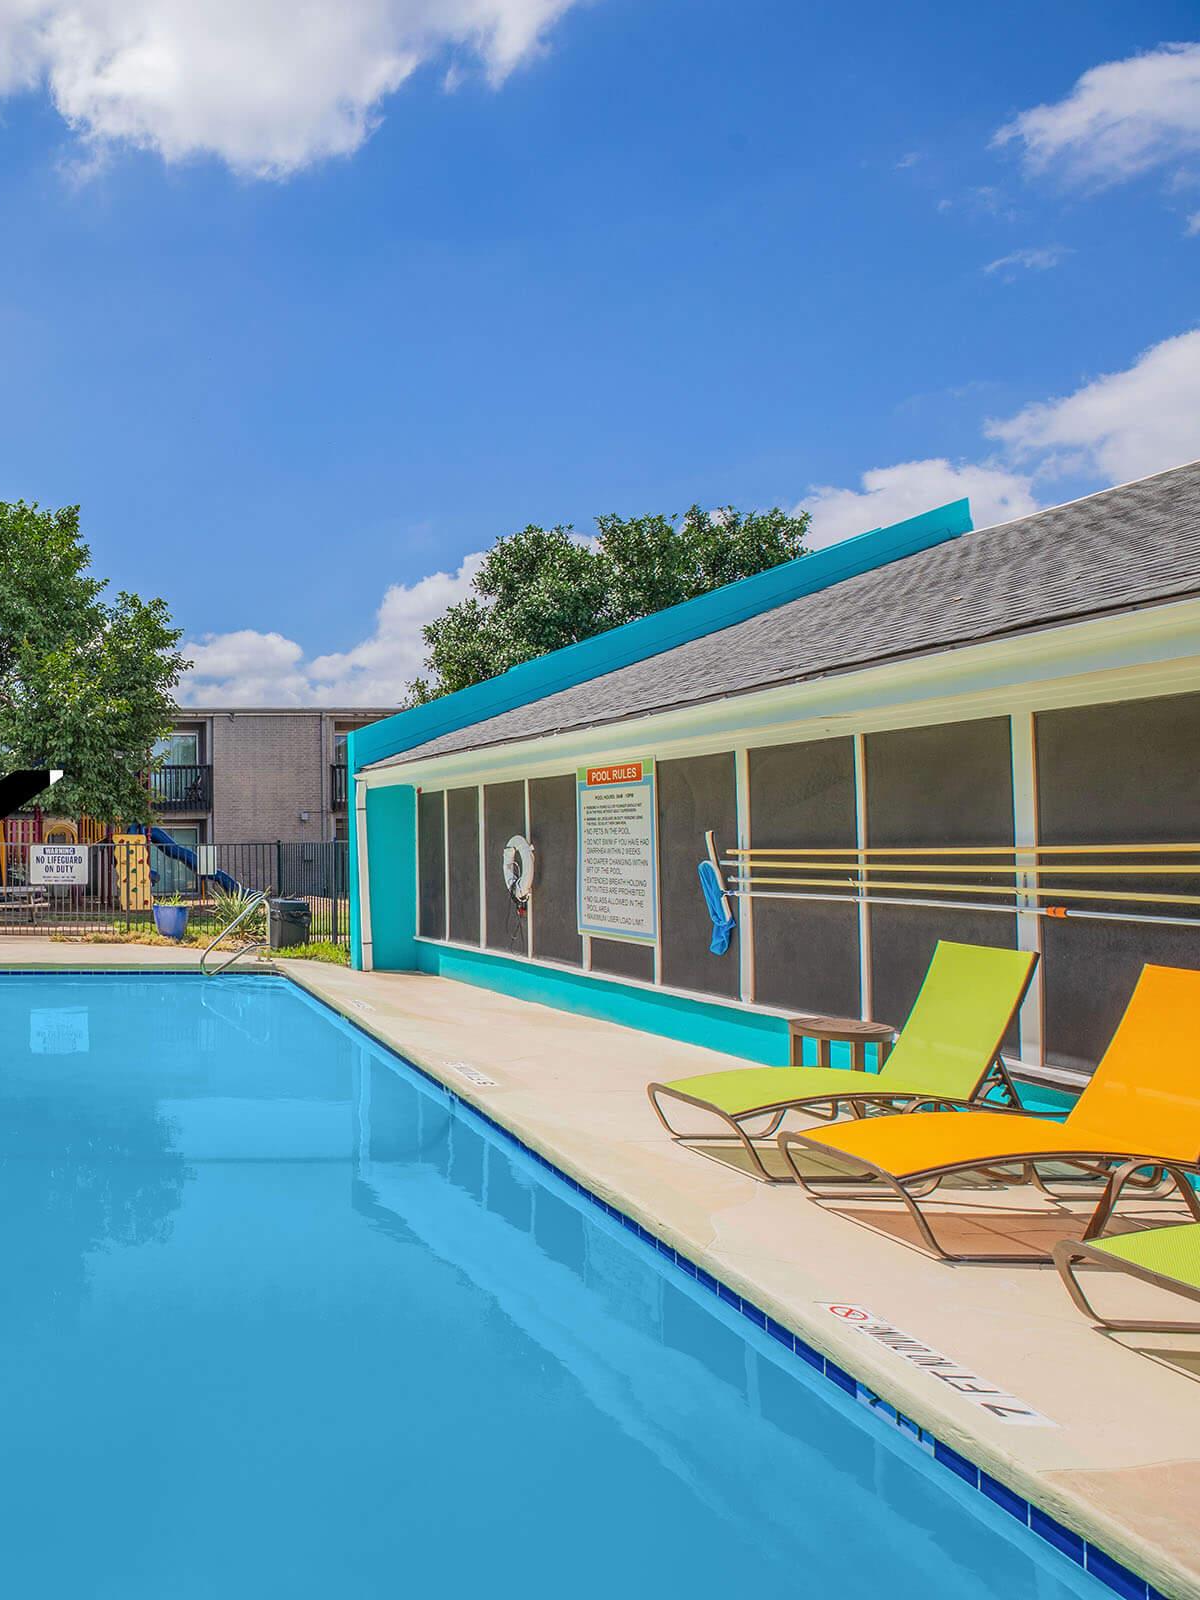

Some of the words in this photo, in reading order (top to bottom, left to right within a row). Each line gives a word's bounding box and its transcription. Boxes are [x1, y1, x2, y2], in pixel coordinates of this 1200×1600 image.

[591, 771, 611, 782] POOL
[612, 767, 637, 780] RULES
[35, 856, 45, 865] NO
[47, 856, 83, 865] LIFEGUARD
[44, 865, 54, 873] ON
[56, 865, 74, 873] DUTY
